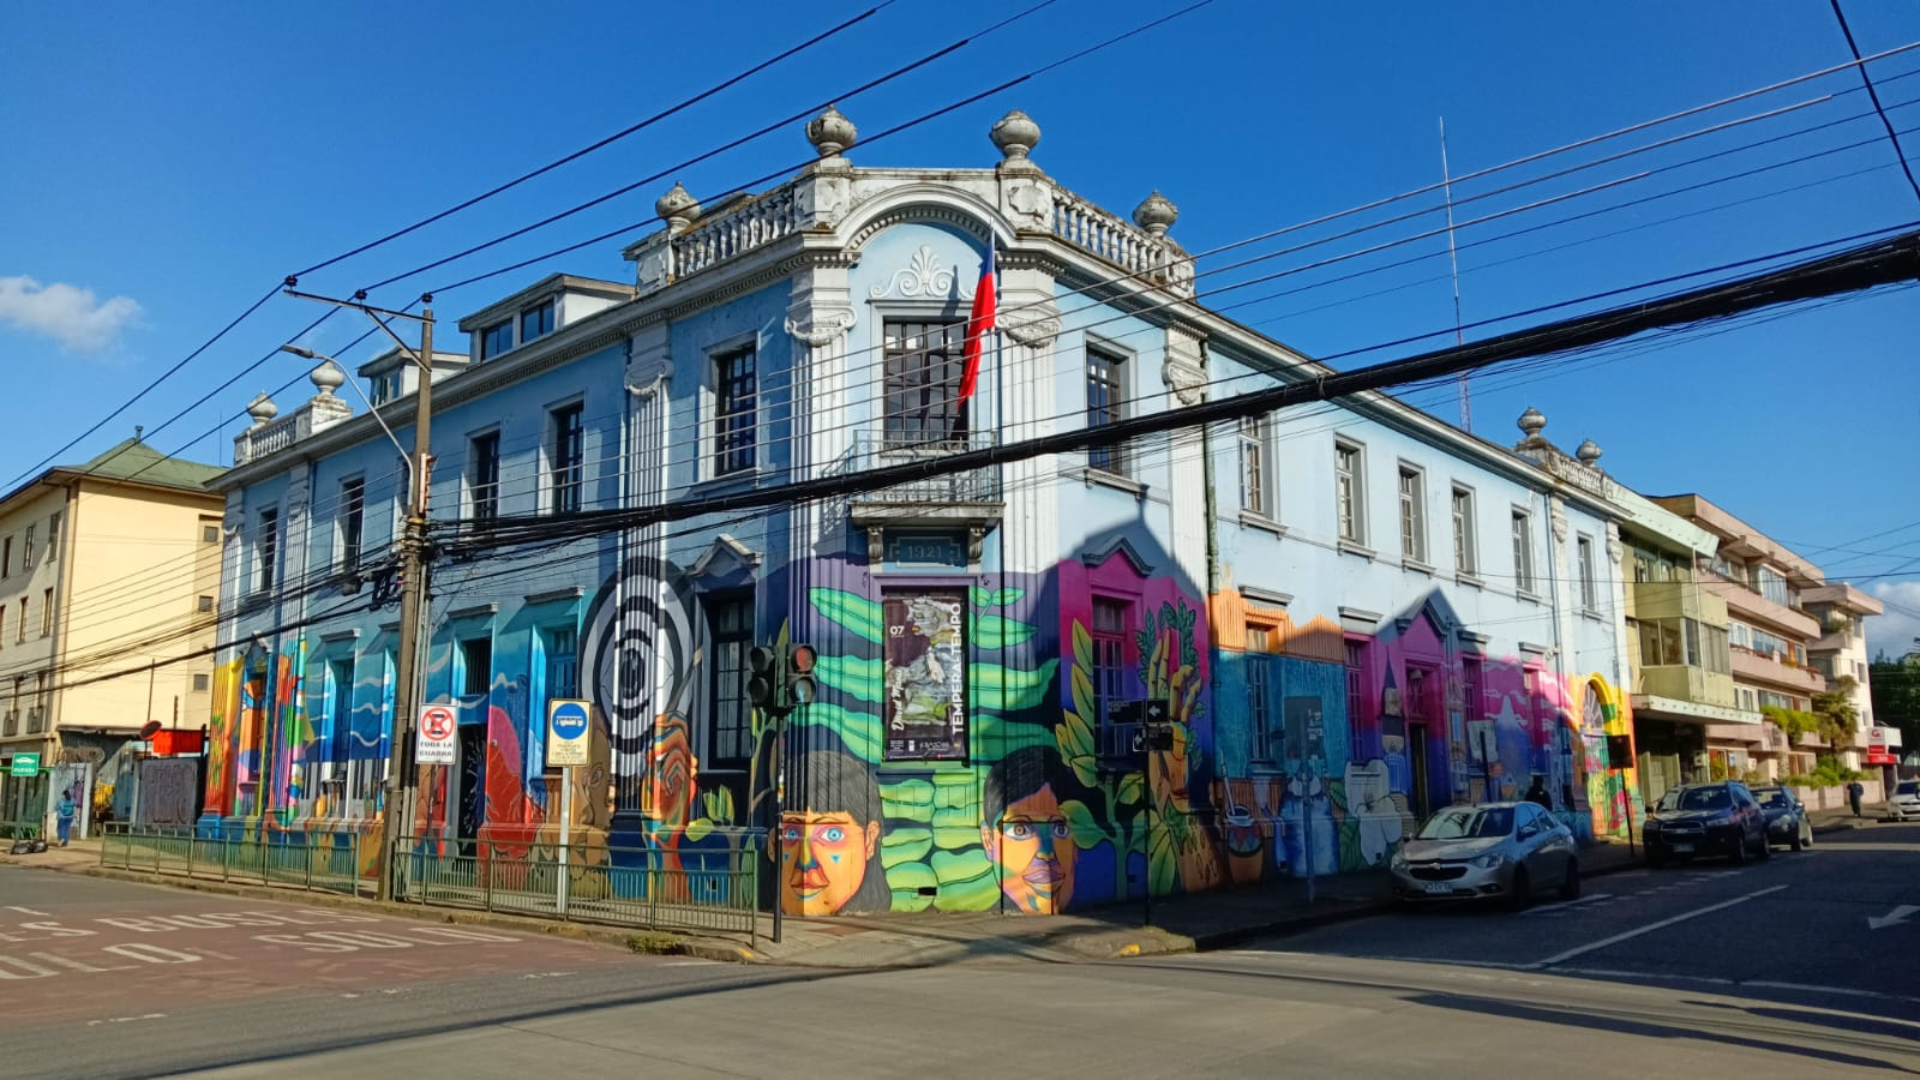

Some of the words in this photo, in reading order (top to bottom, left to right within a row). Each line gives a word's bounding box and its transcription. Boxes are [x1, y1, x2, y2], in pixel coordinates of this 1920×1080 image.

[908, 545, 942, 559] 1921
[889, 625, 905, 635] 07
[93, 910, 382, 932] BUSES
[250, 926, 521, 953] SOLO
